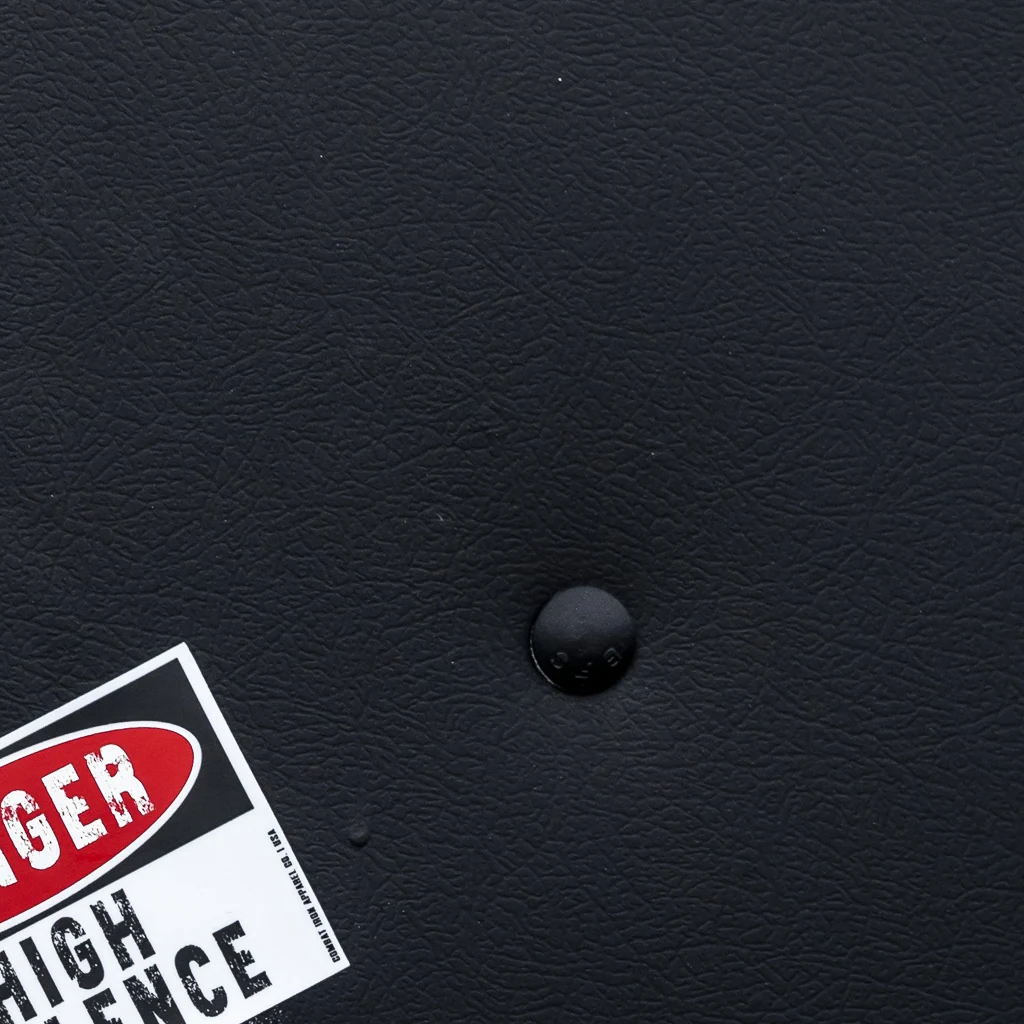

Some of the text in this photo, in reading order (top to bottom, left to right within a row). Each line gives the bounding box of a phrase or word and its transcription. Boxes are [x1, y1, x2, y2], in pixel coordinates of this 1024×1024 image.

[267, 828, 282, 847] USA
[288, 869, 312, 906] APPAREL
[306, 907, 323, 928] IRON
[317, 929, 341, 963] COMBAT
